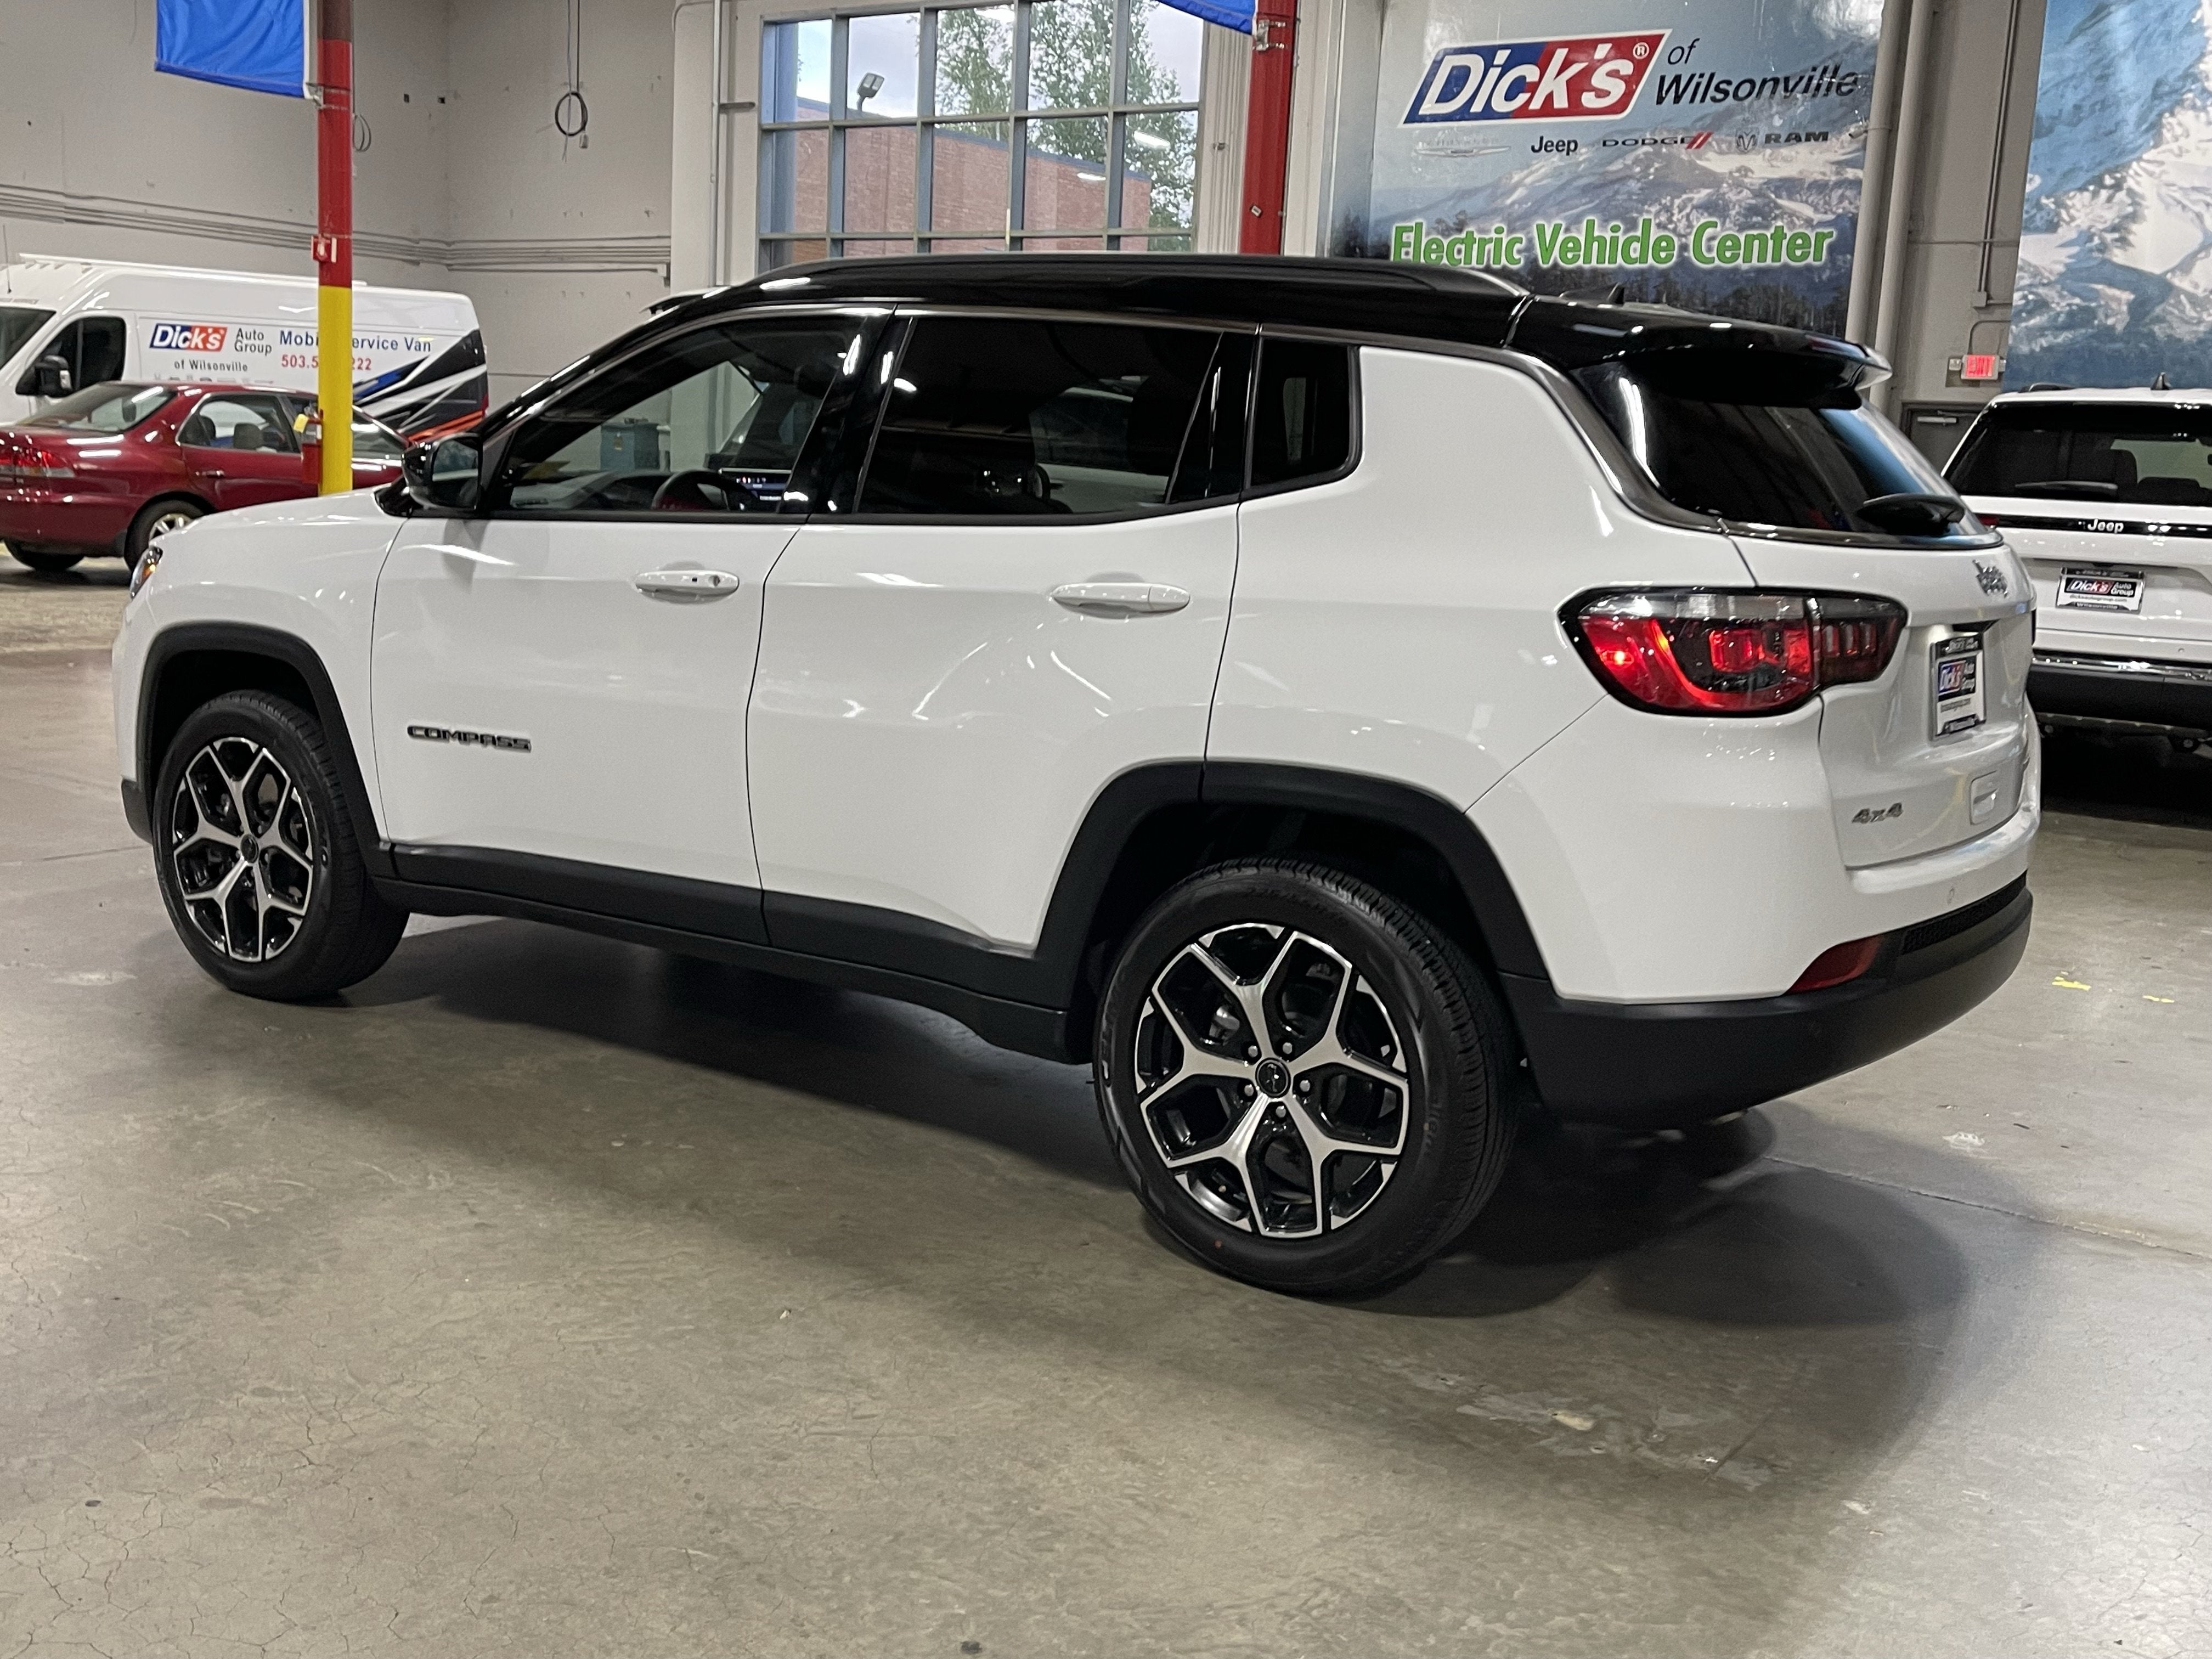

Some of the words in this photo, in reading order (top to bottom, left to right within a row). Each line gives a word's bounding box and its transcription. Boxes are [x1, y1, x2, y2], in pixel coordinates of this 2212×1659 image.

[1418, 43, 1634, 116] Dick's
[1667, 38, 1700, 65] of
[1656, 61, 1859, 105] Wilsonville
[1531, 136, 1578, 156] Jeep
[1764, 131, 1830, 144] RAM
[1392, 222, 1523, 266] Electric
[1536, 218, 1675, 265] Vehicle
[1692, 221, 1834, 264] Center
[153, 325, 222, 350] Dick's
[235, 328, 264, 341] Auto
[234, 339, 272, 356] Group
[280, 330, 319, 346] Mobi
[352, 335, 398, 350] ervice
[404, 336, 431, 352] Van
[174, 359, 185, 370] of
[190, 359, 248, 372] Wilsonville
[2087, 518, 2124, 534] Jeep
[2070, 579, 2109, 592] Dick's
[2113, 582, 2132, 590] Auto
[2111, 588, 2134, 597] Group
[407, 725, 532, 753] COMPASS
